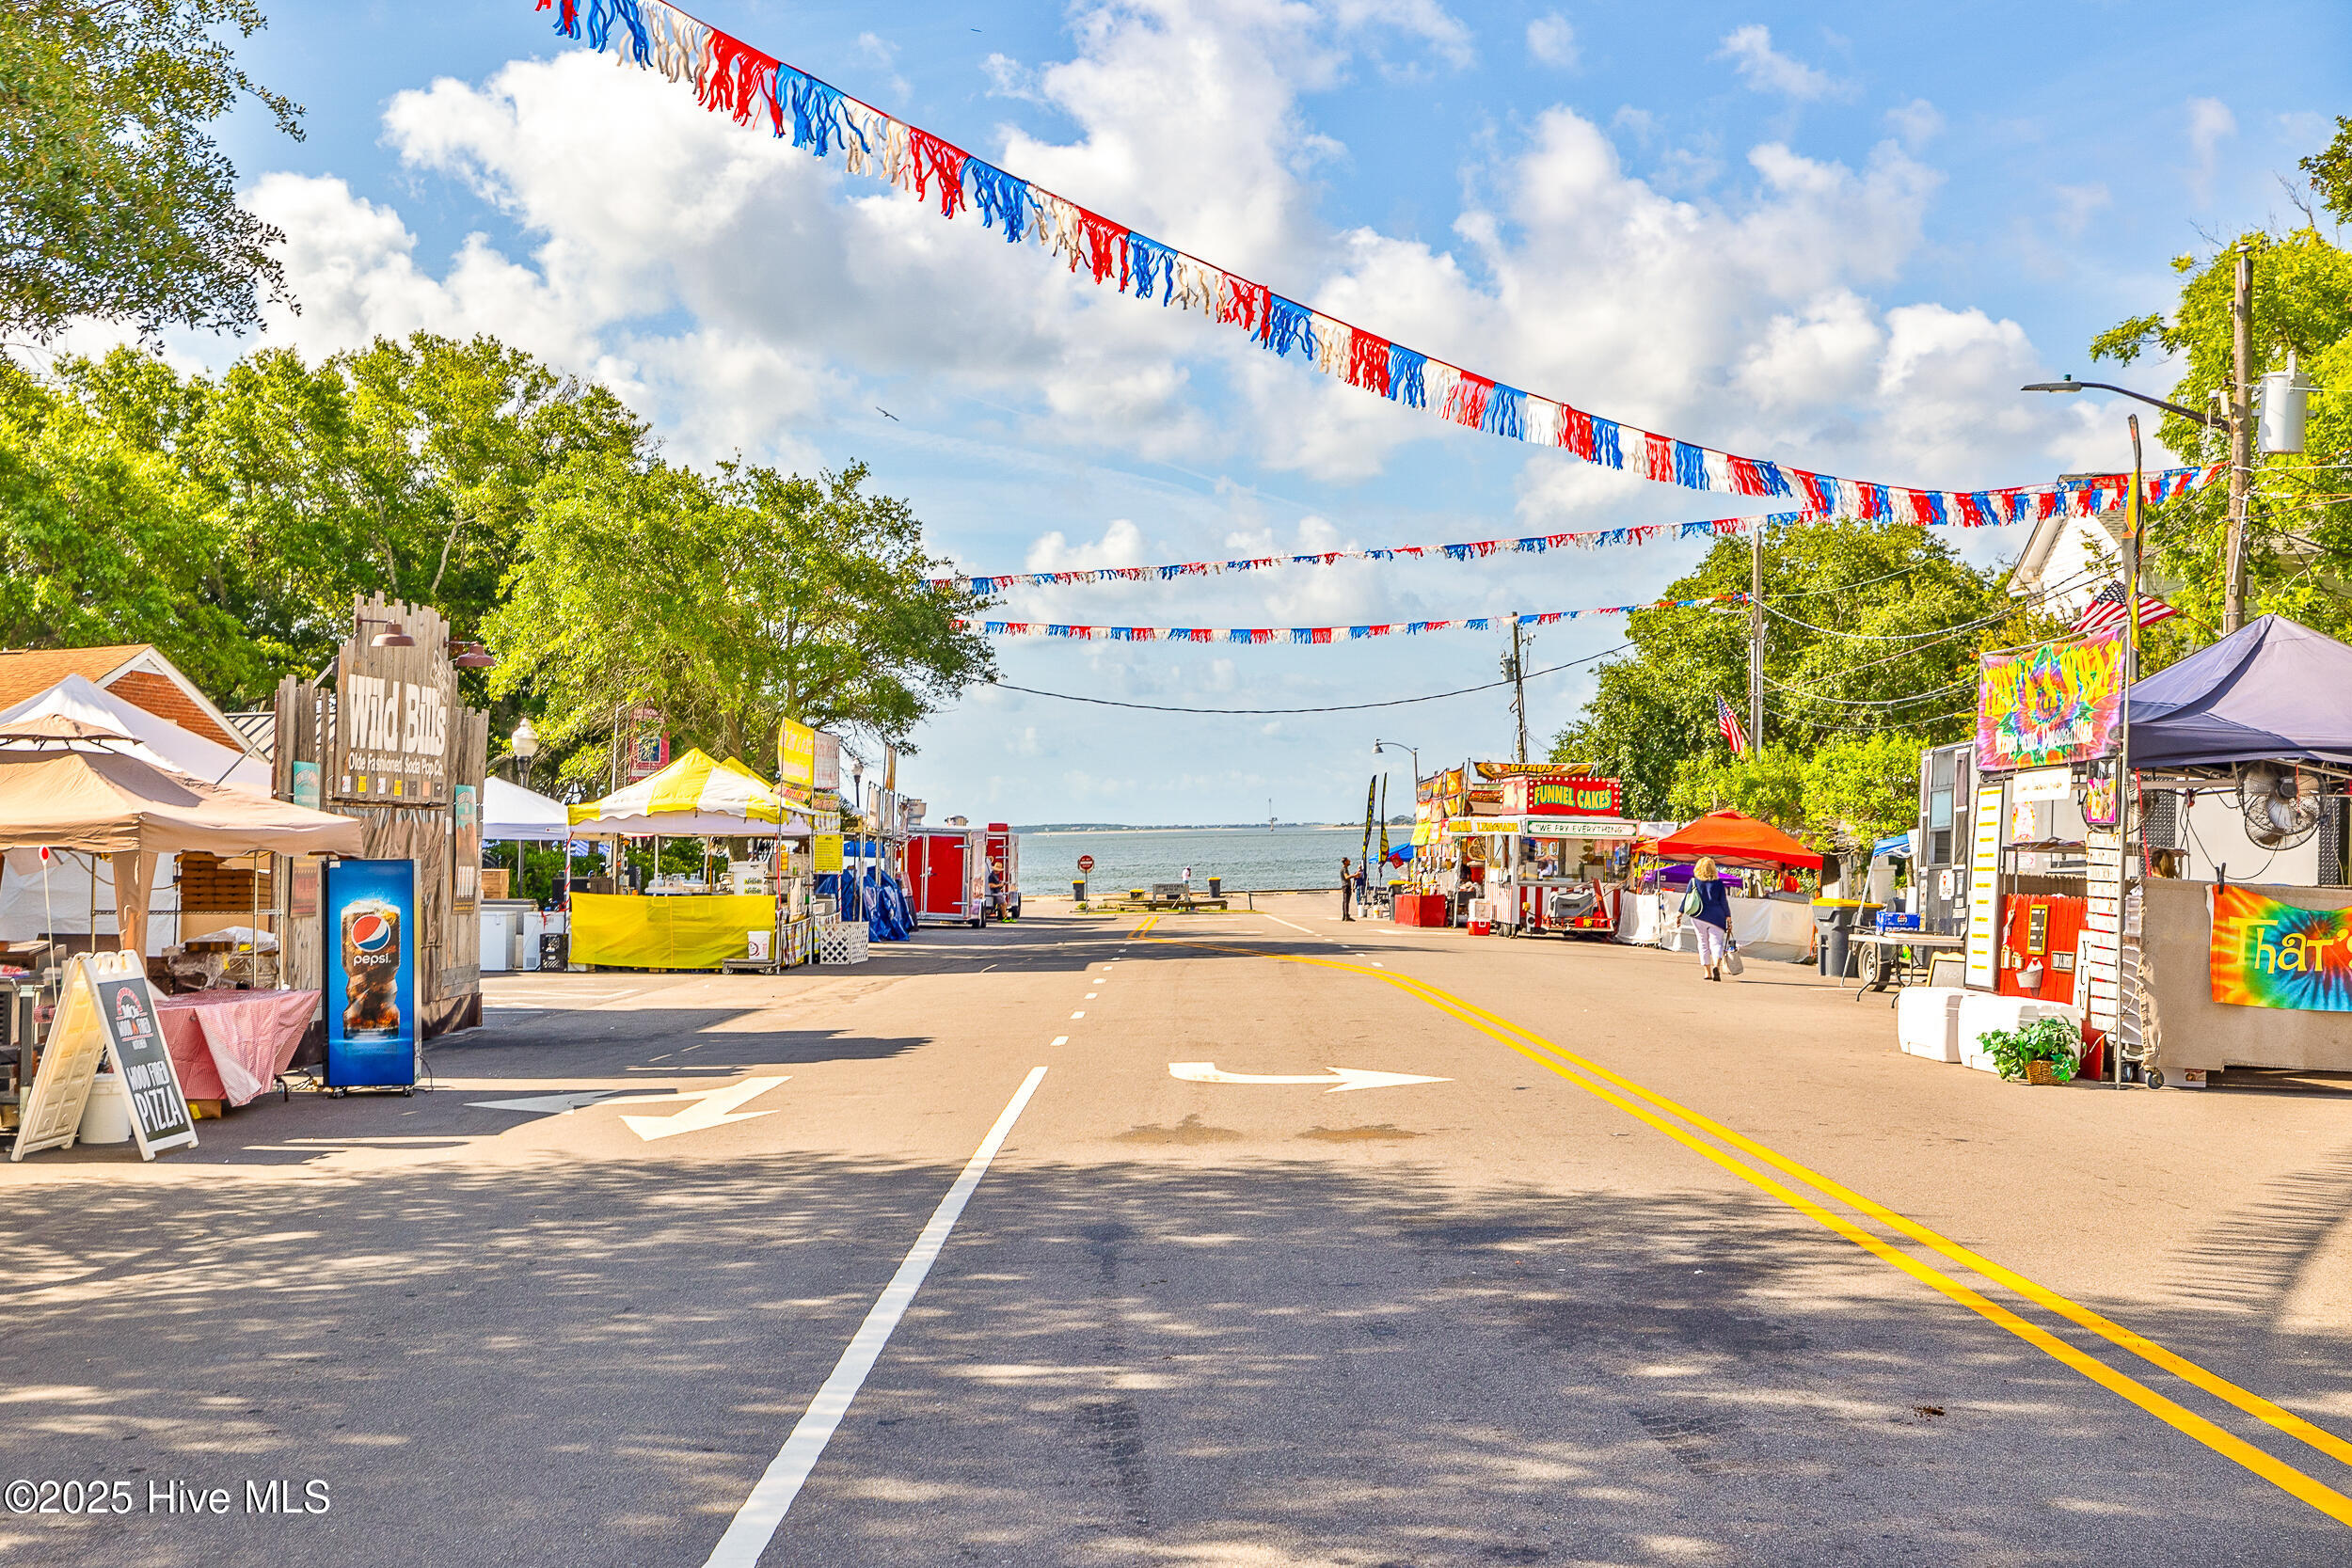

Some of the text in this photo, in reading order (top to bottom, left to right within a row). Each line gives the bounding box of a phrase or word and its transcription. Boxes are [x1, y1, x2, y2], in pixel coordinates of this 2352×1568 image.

[348, 673, 400, 752] Wild
[348, 752, 445, 778] Olde Fashioned Soda Pop Co.
[1534, 784, 1613, 811] FUNNEL CAKES
[353, 954, 391, 966] pepsi
[126, 1060, 170, 1092] WOOD FIRED
[134, 1085, 184, 1134] PIZZA
